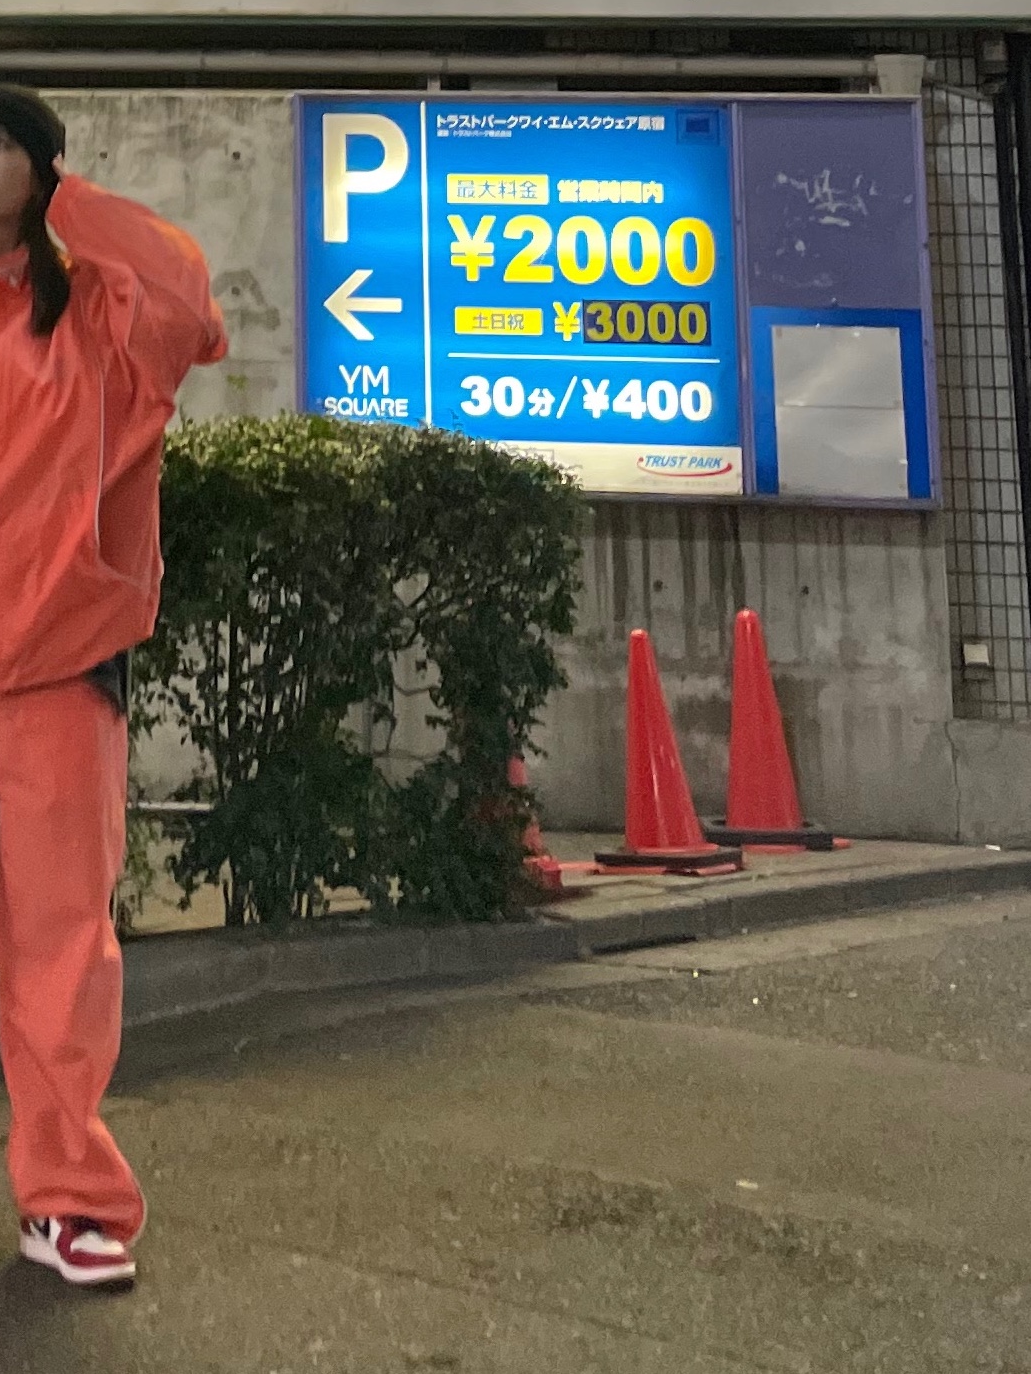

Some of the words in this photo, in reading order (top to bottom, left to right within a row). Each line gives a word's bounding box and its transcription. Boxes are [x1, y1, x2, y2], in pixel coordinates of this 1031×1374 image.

[322, 112, 409, 243] P
[456, 179, 539, 200] 最大料金
[446, 213, 716, 287] ¥2000
[471, 312, 525, 331] 土日祝
[552, 300, 709, 345] ¥3000
[338, 364, 390, 396] YM
[324, 396, 409, 418] SQUARE
[644, 455, 687, 469] TRUST
[688, 456, 723, 469] PARK
